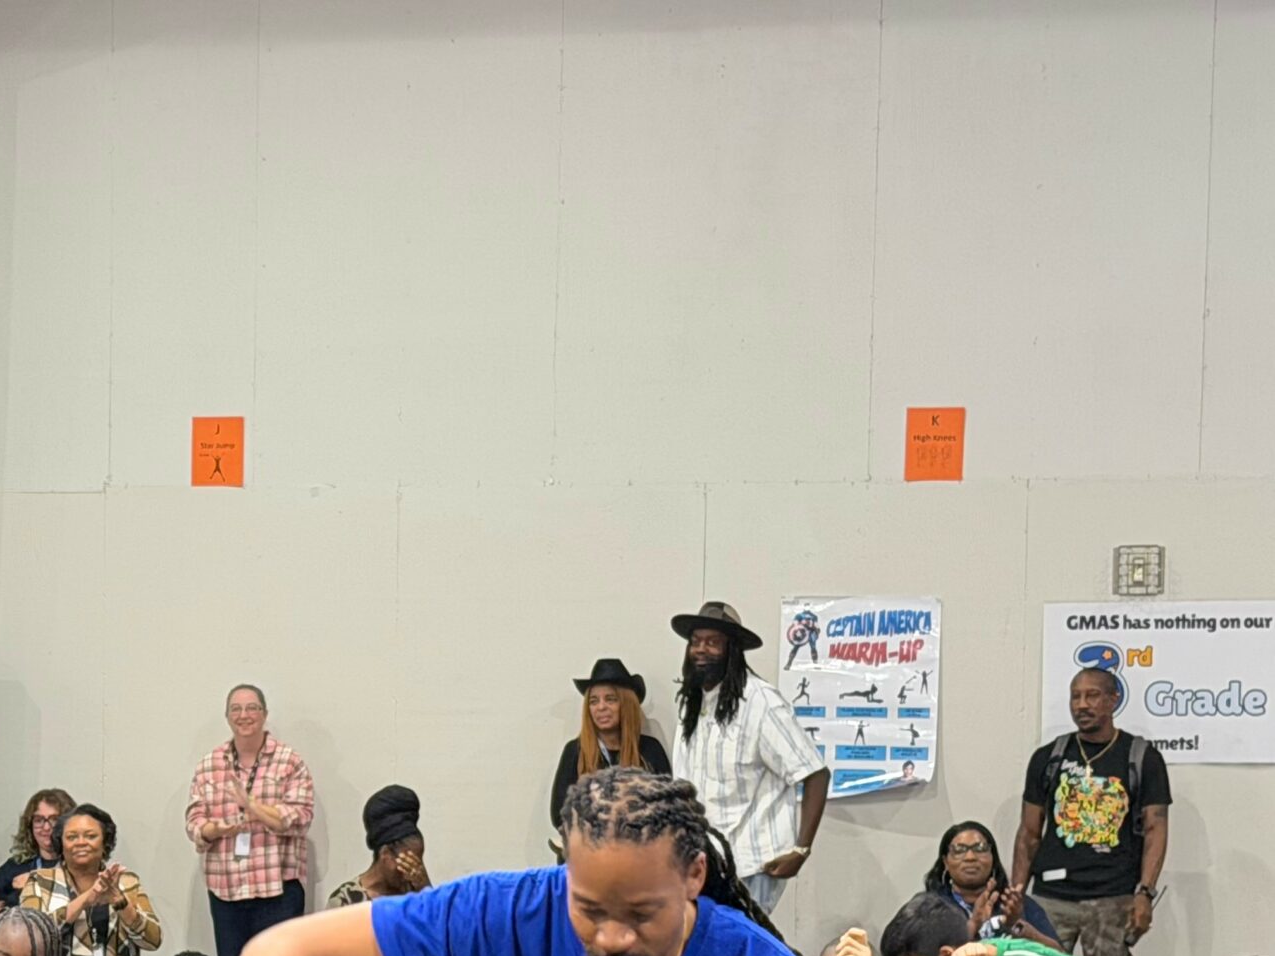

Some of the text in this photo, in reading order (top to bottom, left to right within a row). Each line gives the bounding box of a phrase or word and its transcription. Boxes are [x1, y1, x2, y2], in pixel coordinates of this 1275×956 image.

[877, 608, 932, 636] AMERICA
[1066, 614, 1273, 632] GMAS has nothing on our
[828, 638, 925, 667] WARM-UP
[1144, 680, 1268, 717] Grade
[1147, 735, 1199, 750] mets!
